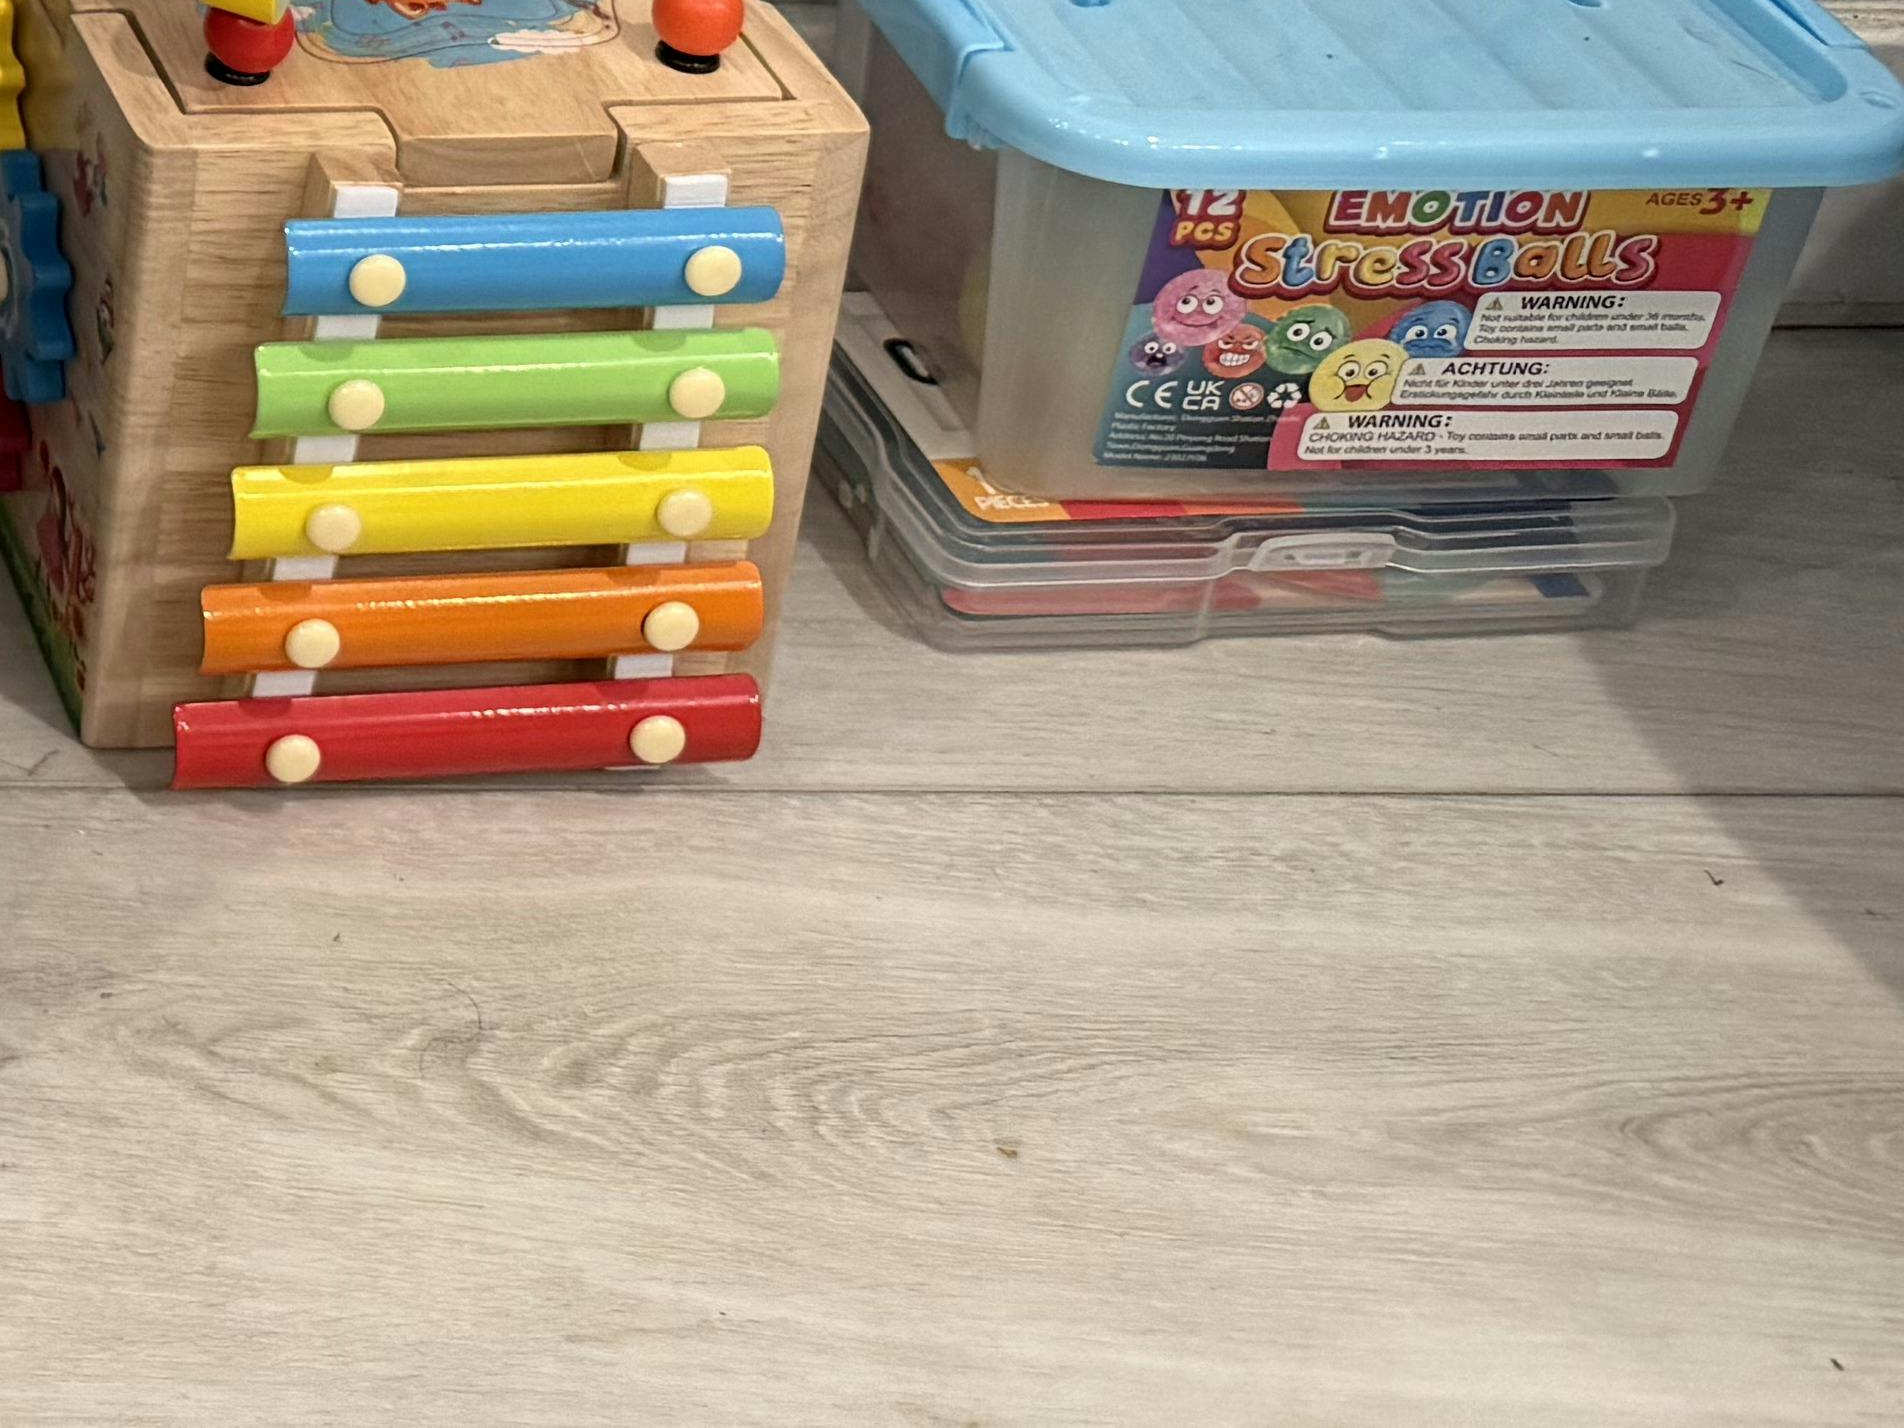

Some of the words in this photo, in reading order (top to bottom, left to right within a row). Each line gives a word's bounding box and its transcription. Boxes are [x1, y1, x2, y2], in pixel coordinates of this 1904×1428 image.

[1184, 190, 1241, 217] 12
[1327, 190, 1590, 232] EMOTION
[1646, 192, 1702, 206] AGES
[1700, 188, 1753, 216] 3+
[1175, 221, 1234, 242] PCS
[1235, 233, 1467, 291] Stress
[1469, 231, 1659, 288] Balls
[1520, 296, 1626, 310] WARNING:
[1441, 361, 1550, 376] ACHTUNG:
[1186, 380, 1226, 396] UK
[1181, 395, 1222, 411] CA
[1347, 414, 1453, 429] WARNING:
